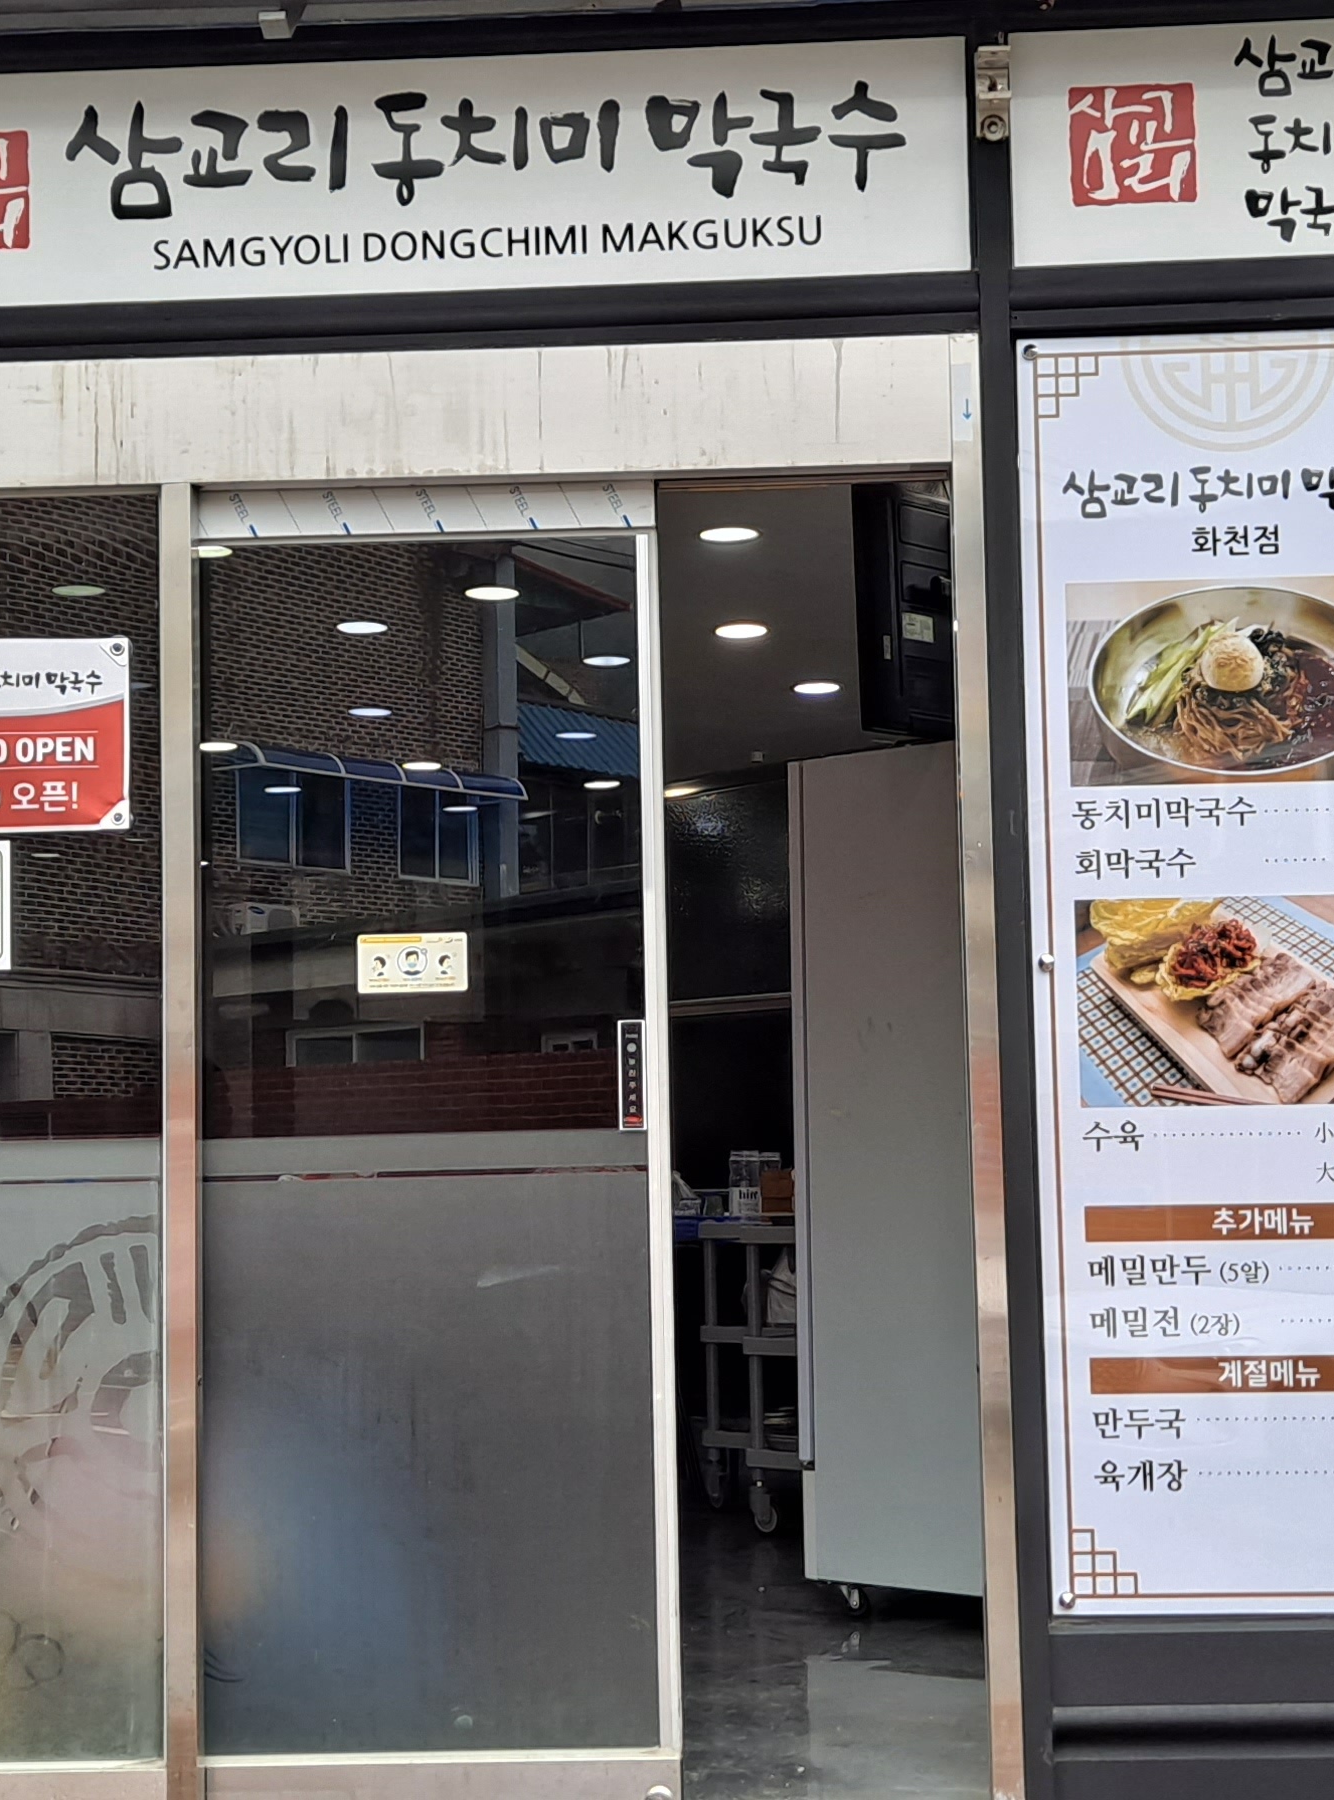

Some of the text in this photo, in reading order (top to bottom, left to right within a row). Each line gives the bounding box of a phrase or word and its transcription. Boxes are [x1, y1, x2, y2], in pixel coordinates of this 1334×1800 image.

[65, 81, 906, 220] 삼교리 동치미 막국수
[153, 214, 823, 273] SAMGYOLI DONGCHIMI MAKGUKSU
[1062, 469, 1179, 519] 삼교리
[1188, 465, 1291, 513] 동치미
[1191, 524, 1280, 557] 화천점
[46, 670, 103, 695] 막국수
[16, 736, 95, 763] OPEN
[11, 781, 78, 812] 오픈!
[1071, 796, 1257, 829] 동치미막국수
[1074, 847, 1196, 880] 회막국수
[1082, 1121, 1144, 1152] 수육
[1314, 1122, 1334, 1143] 小
[1212, 1209, 1315, 1236] 추가메뉴
[1087, 1254, 1212, 1287] 메밀만두
[1219, 1261, 1270, 1284] (5알)
[1090, 1306, 1181, 1338] 메밀전
[1190, 1313, 1240, 1337] (2장)
[1218, 1360, 1321, 1387] 계절메뉴
[1093, 1407, 1186, 1440] 만두국
[1094, 1459, 1188, 1492] 육개장
